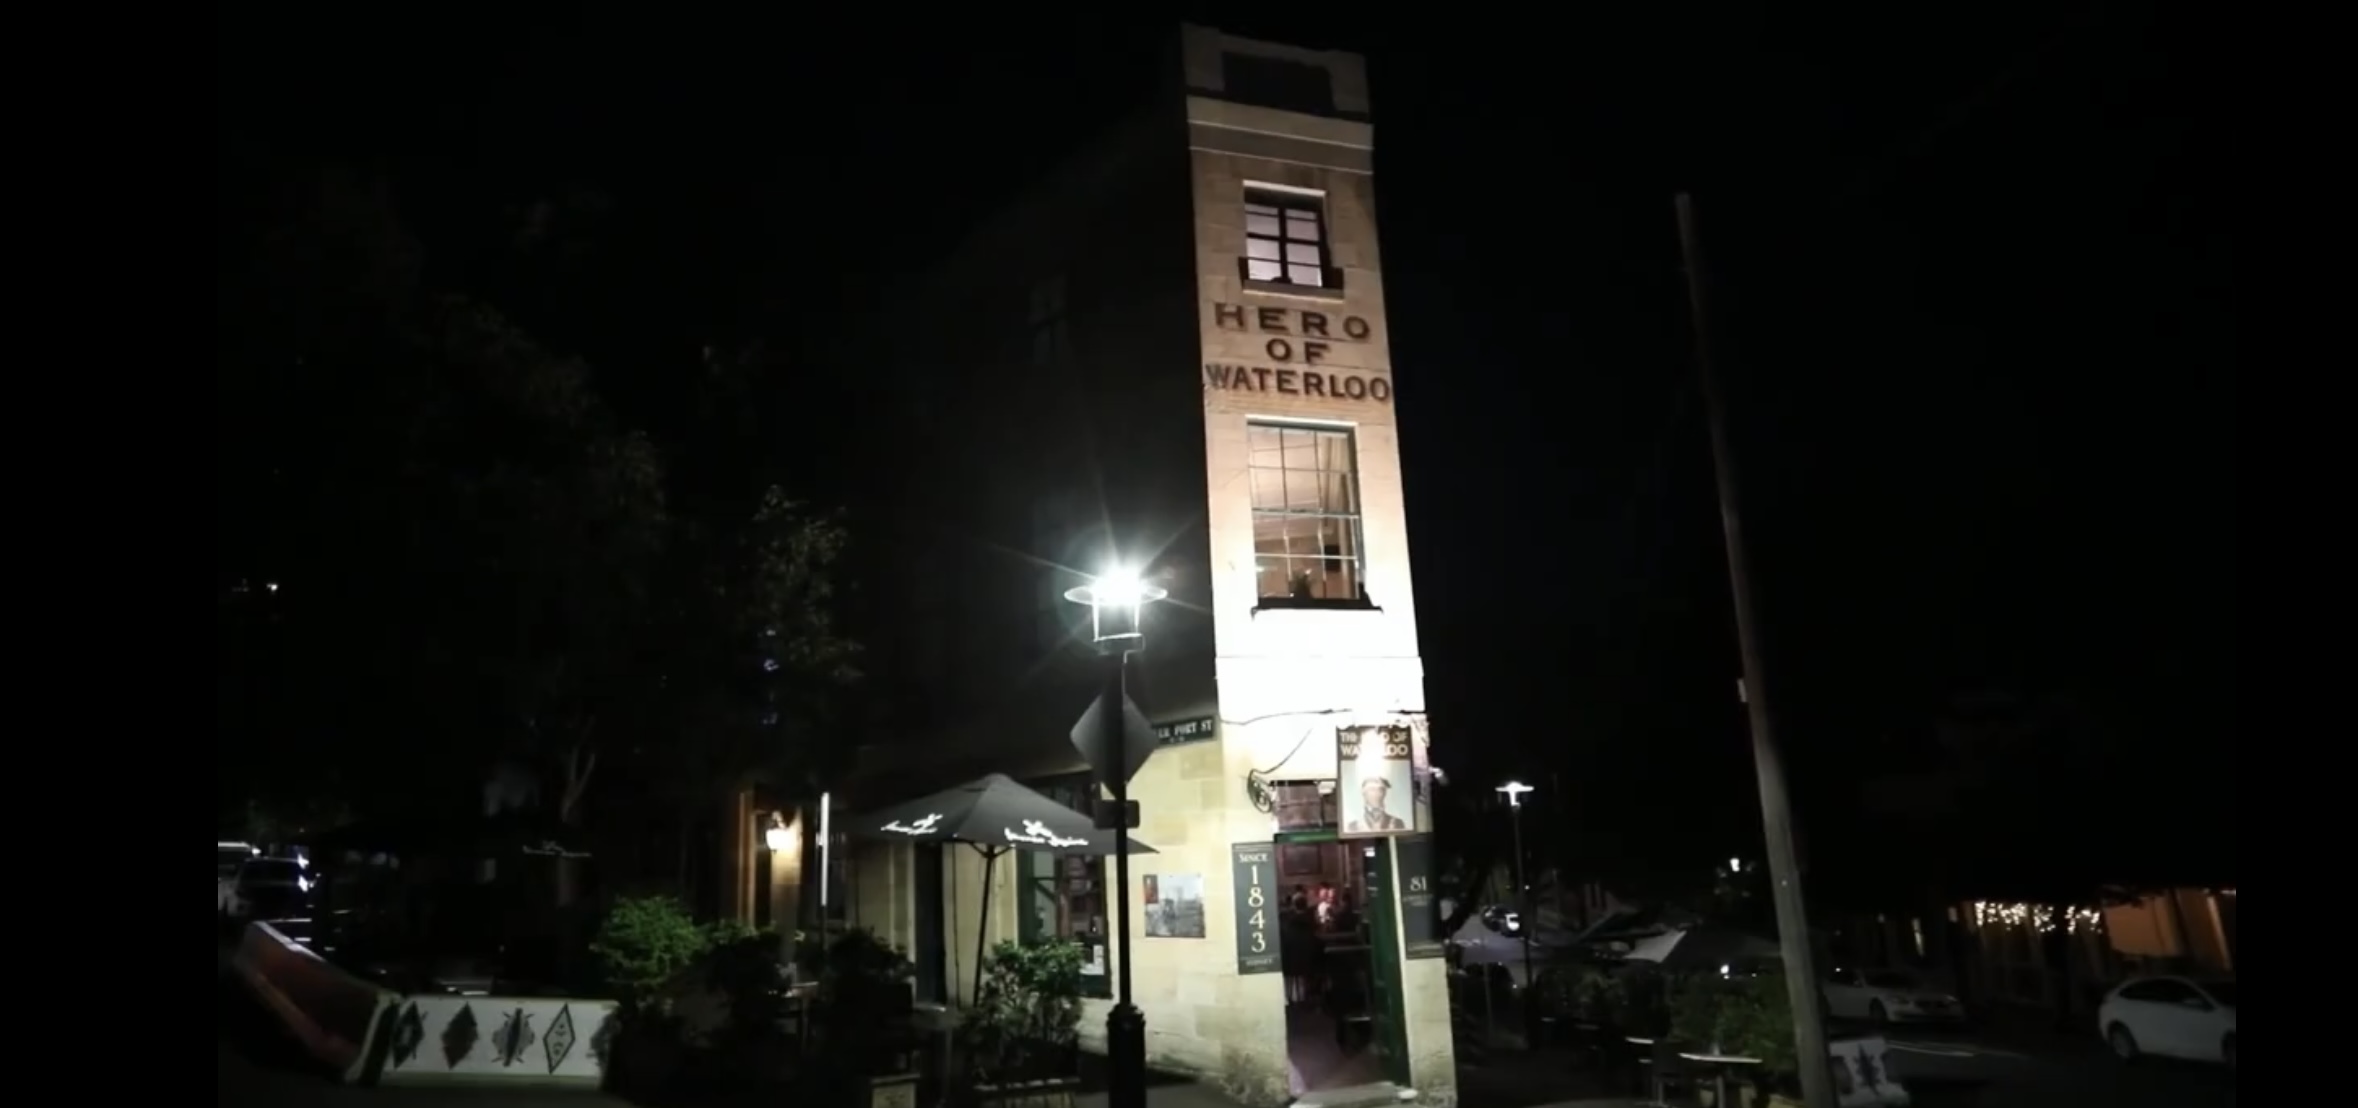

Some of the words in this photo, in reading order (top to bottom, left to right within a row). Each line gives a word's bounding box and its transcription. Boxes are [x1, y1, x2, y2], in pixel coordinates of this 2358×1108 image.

[1214, 302, 1370, 339] HERO
[1265, 337, 1330, 364] OF
[1205, 363, 1390, 402] WATERLOO
[1409, 875, 1428, 892] 81
